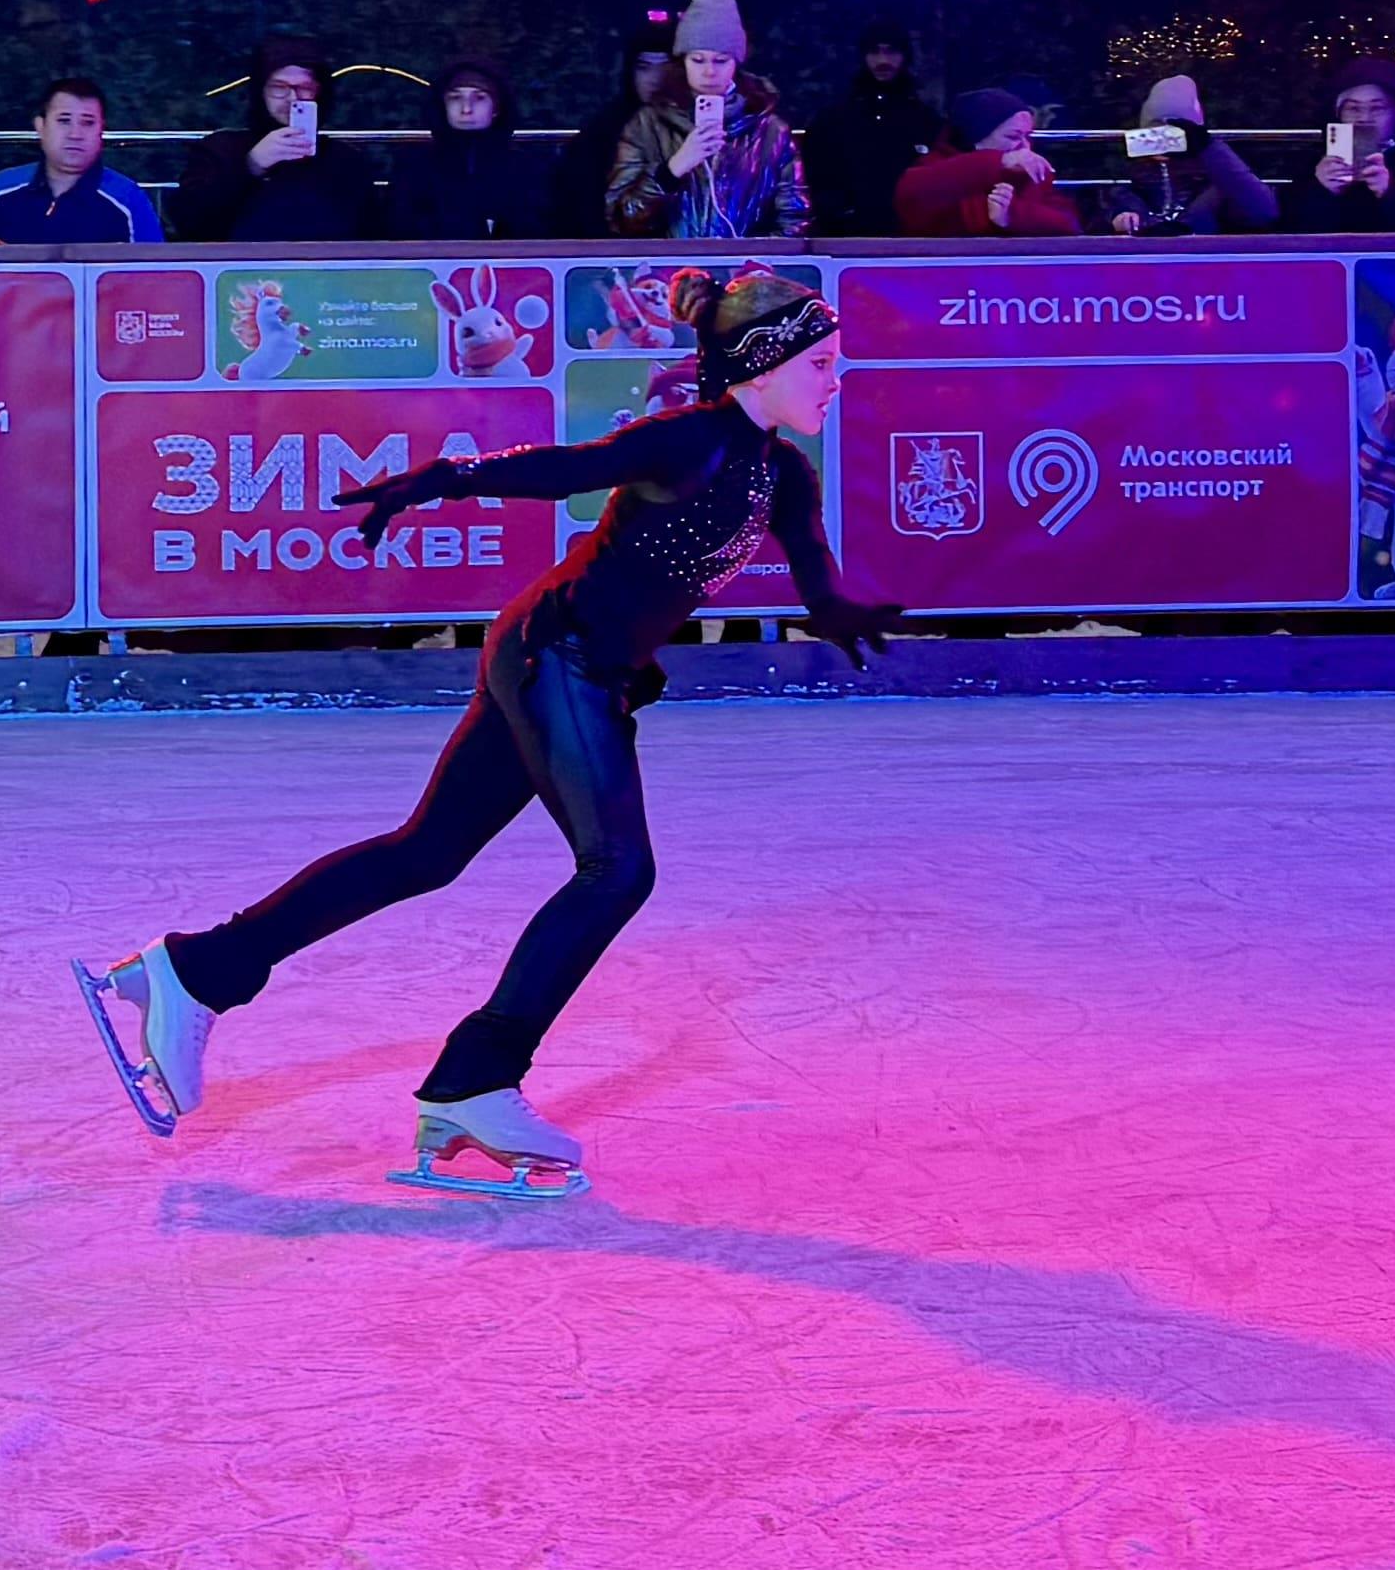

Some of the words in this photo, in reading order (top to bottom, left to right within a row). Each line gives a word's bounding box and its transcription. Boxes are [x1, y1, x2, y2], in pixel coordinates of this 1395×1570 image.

[939, 289, 1246, 325] zima.mos.ru
[317, 336, 418, 349] zima.mos.ru
[1120, 442, 1292, 468] Московский
[1120, 478, 1264, 503] транспорт
[154, 530, 197, 572] В
[222, 525, 504, 571] МОСКВЕ
